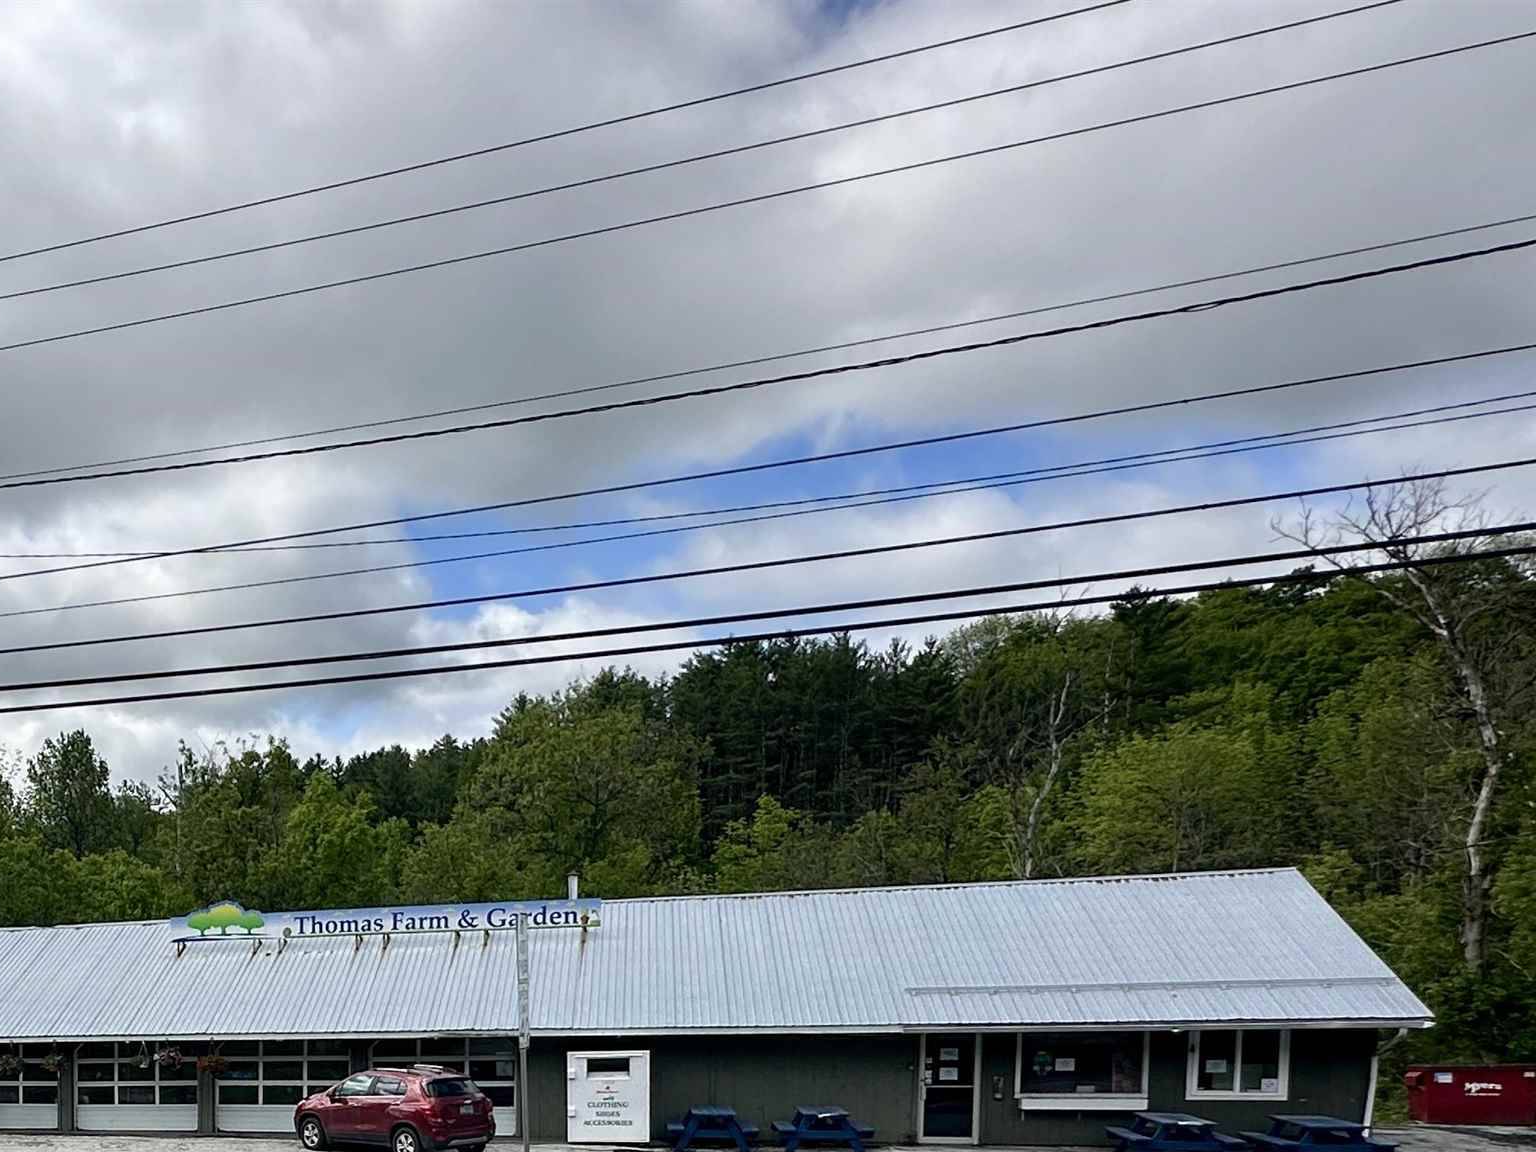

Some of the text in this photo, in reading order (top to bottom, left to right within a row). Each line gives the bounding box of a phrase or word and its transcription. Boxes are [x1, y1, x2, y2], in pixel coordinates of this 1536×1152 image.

[294, 915, 385, 935] Thomas
[390, 911, 449, 931] Farm
[457, 908, 479, 929] &
